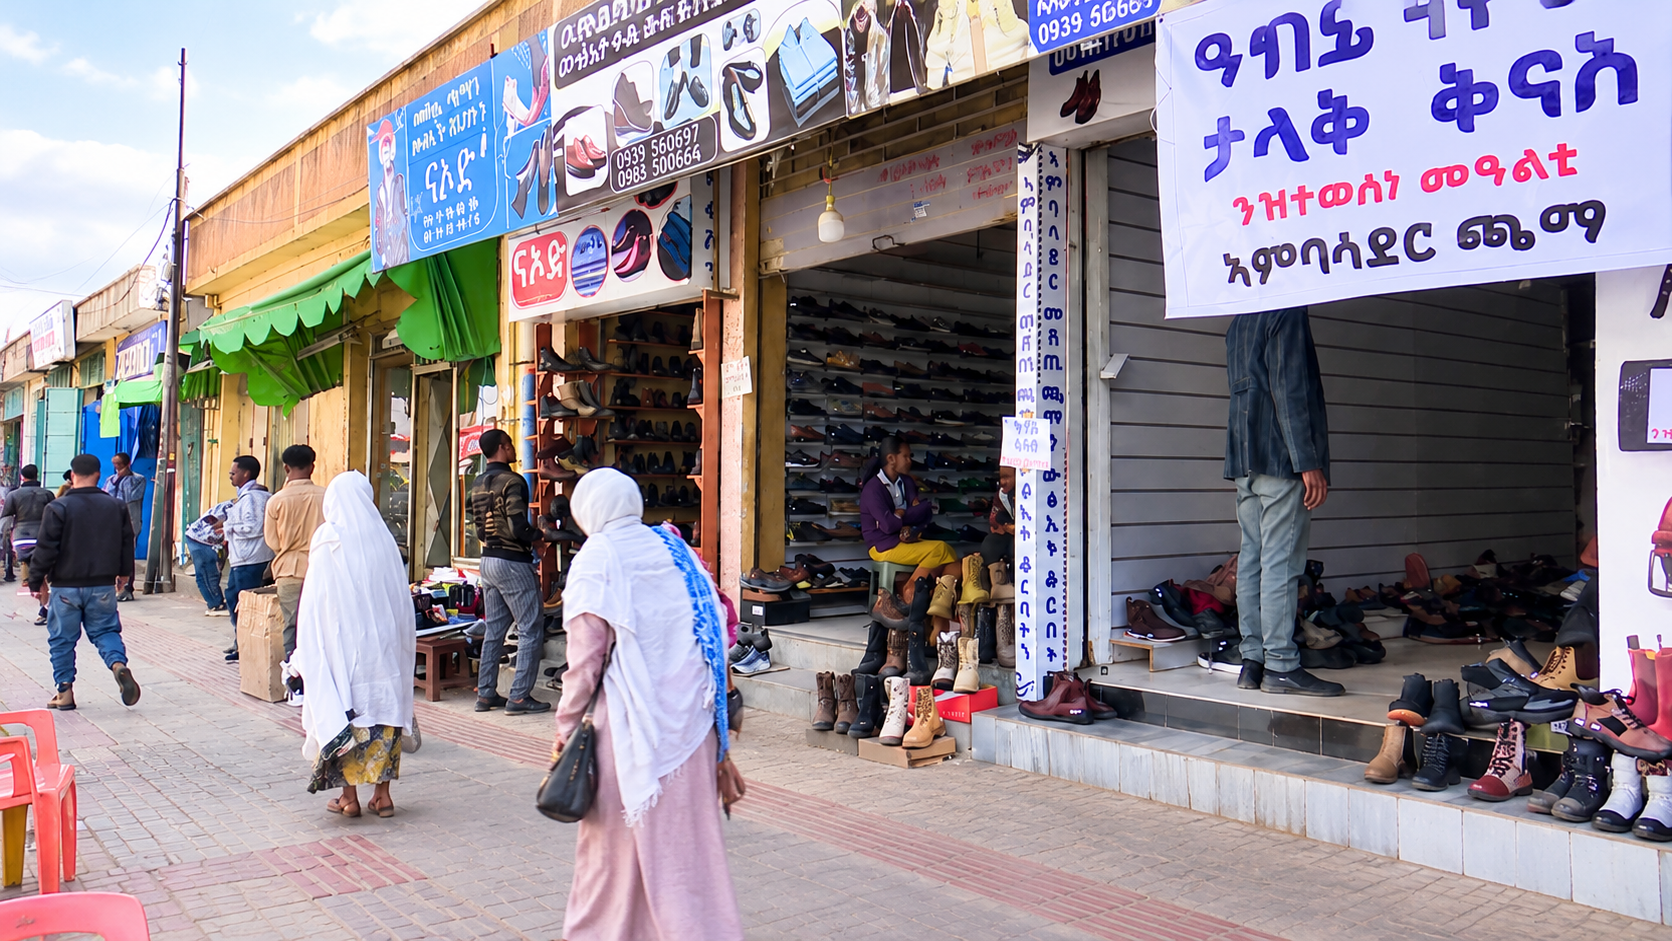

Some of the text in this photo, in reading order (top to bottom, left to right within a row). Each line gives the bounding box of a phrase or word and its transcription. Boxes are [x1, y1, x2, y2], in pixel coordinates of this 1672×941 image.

[1037, 11, 1083, 45] 0939
[616, 123, 700, 170] 0939 560697
[1203, 88, 1370, 183] ታላቅ
[617, 163, 647, 188] 0983
[1232, 142, 1578, 227] ንዝተወሰነ መዓልቲ
[1223, 199, 1607, 288] ኣምባሳደር ጫማ
